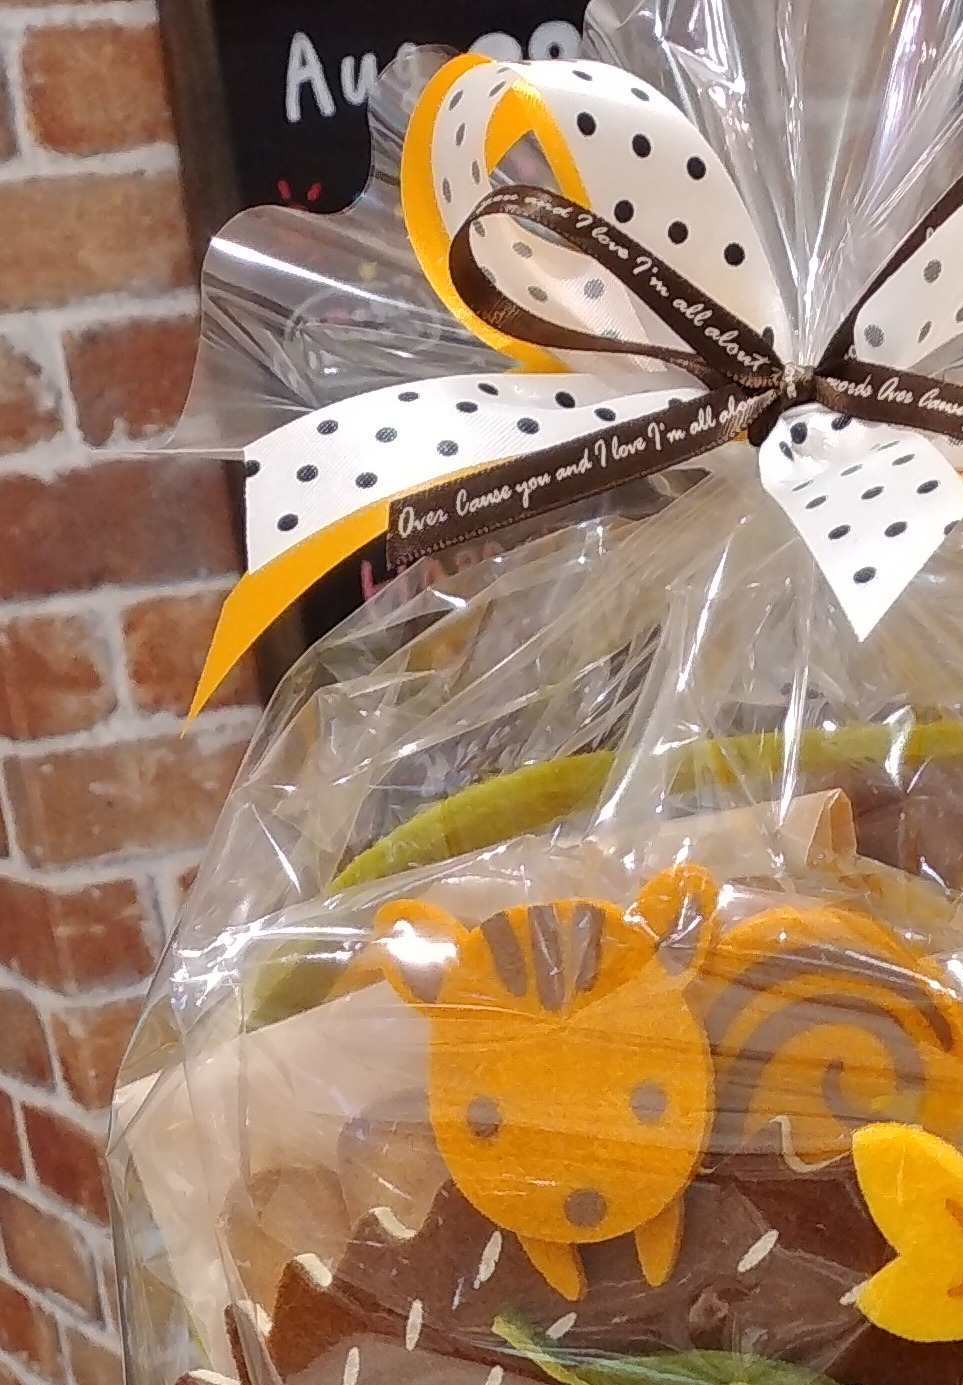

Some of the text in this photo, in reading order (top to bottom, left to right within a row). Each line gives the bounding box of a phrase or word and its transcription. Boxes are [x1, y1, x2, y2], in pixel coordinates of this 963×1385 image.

[591, 226, 629, 259] love
[672, 297, 710, 328] all
[877, 377, 914, 404] Over
[399, 506, 449, 539] Over
[456, 487, 512, 518] Cause
[515, 473, 551, 508] you
[556, 448, 592, 481] and
[612, 436, 647, 461] love
[647, 422, 686, 451] I'm
[689, 406, 716, 436] all
